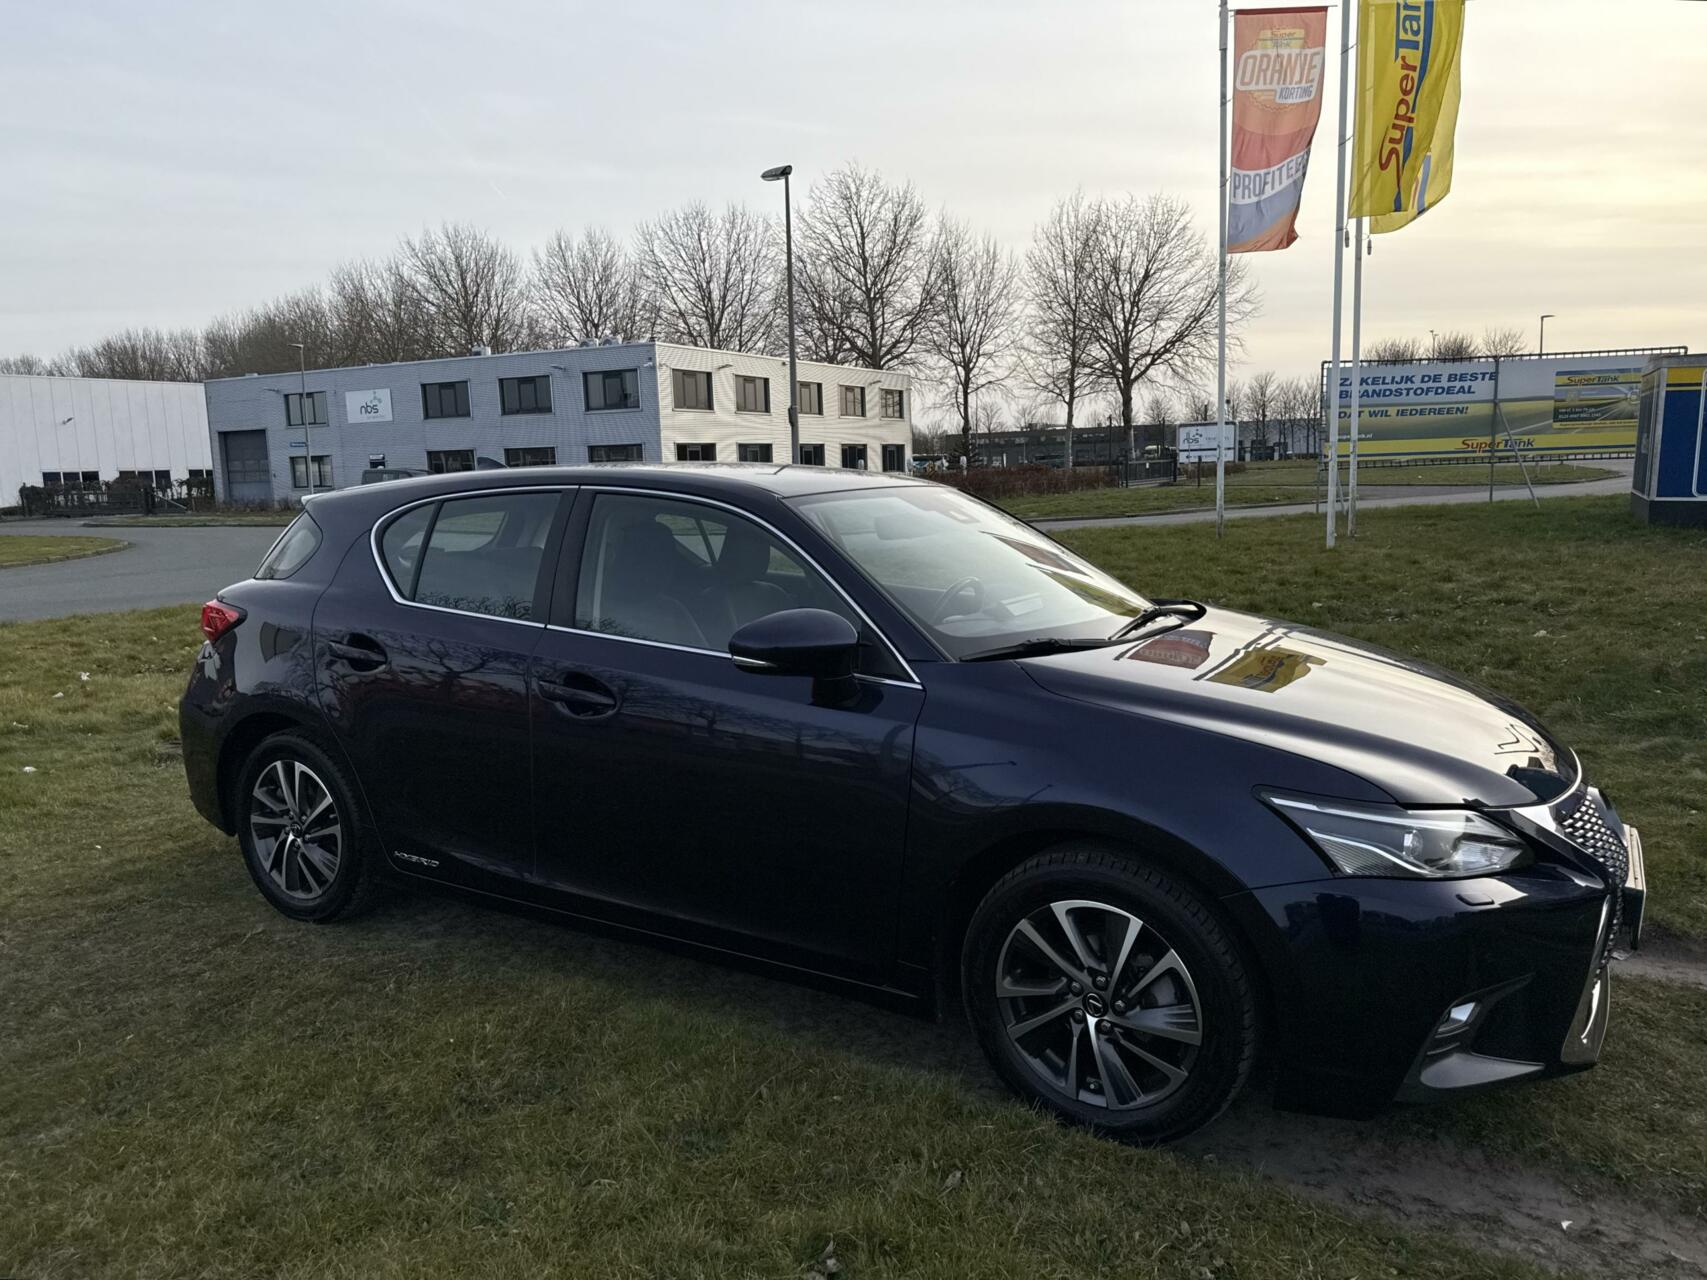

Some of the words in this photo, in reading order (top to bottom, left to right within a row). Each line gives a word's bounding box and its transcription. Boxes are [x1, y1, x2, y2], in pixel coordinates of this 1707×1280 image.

[1239, 52, 1321, 87] ORANJE
[1278, 85, 1313, 100] KORTING
[1339, 374, 1415, 387] ZKELIJK
[1421, 373, 1442, 384] DE
[1447, 371, 1497, 383] BESTE
[1339, 385, 1475, 399] BANDSTOFDEAL
[360, 402, 379, 415] nbs
[1368, 409, 1391, 418] WIL
[1396, 406, 1468, 417] IEDEREEN!
[1458, 438, 1535, 453] SuperTank
